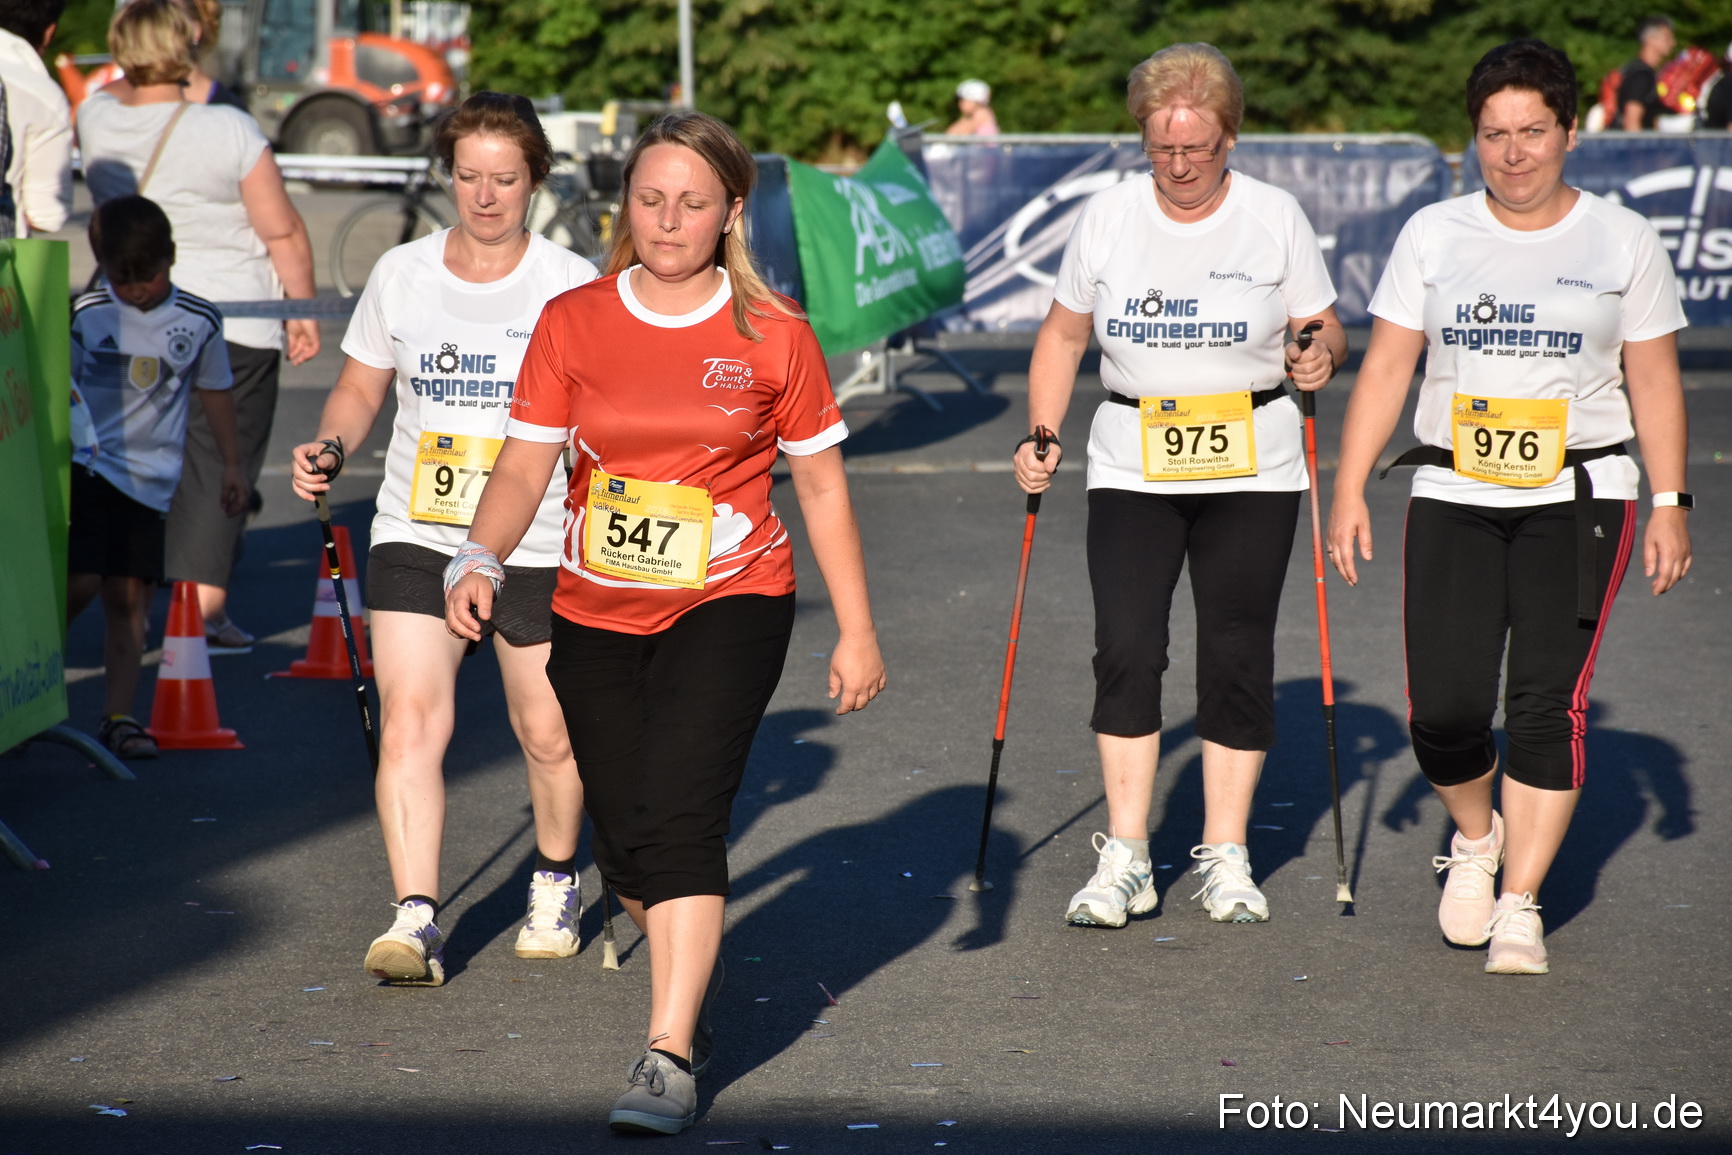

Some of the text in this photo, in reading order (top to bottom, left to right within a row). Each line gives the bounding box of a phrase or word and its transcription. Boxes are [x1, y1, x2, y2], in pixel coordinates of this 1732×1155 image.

[1209, 271, 1252, 282] Roswitha
[1556, 277, 1593, 289] Kerstin
[1107, 318, 1247, 343] Engineering
[1162, 340, 1181, 348] build
[1185, 342, 1205, 350] your
[1441, 327, 1583, 354] Engineering
[1519, 350, 1540, 359] your
[1543, 350, 1566, 358] tools
[703, 358, 753, 378] Town &
[702, 370, 754, 389] Country
[459, 399, 477, 407] build
[481, 400, 501, 409] your
[1164, 424, 1229, 456] 975
[1474, 428, 1539, 461] 976
[1168, 456, 1229, 466] Stoll Roswitha
[1478, 459, 1536, 471] König Kerstin
[1472, 467, 1487, 475] König
[1488, 469, 1522, 479] Engineering
[434, 498, 459, 508] Ferstl
[600, 488, 642, 505] firmenlauf
[428, 507, 444, 515] König
[606, 512, 680, 555] 547
[600, 546, 682, 569] Rückert Gabrielle
[605, 559, 673, 576] FIMA Hausbau GmbH
